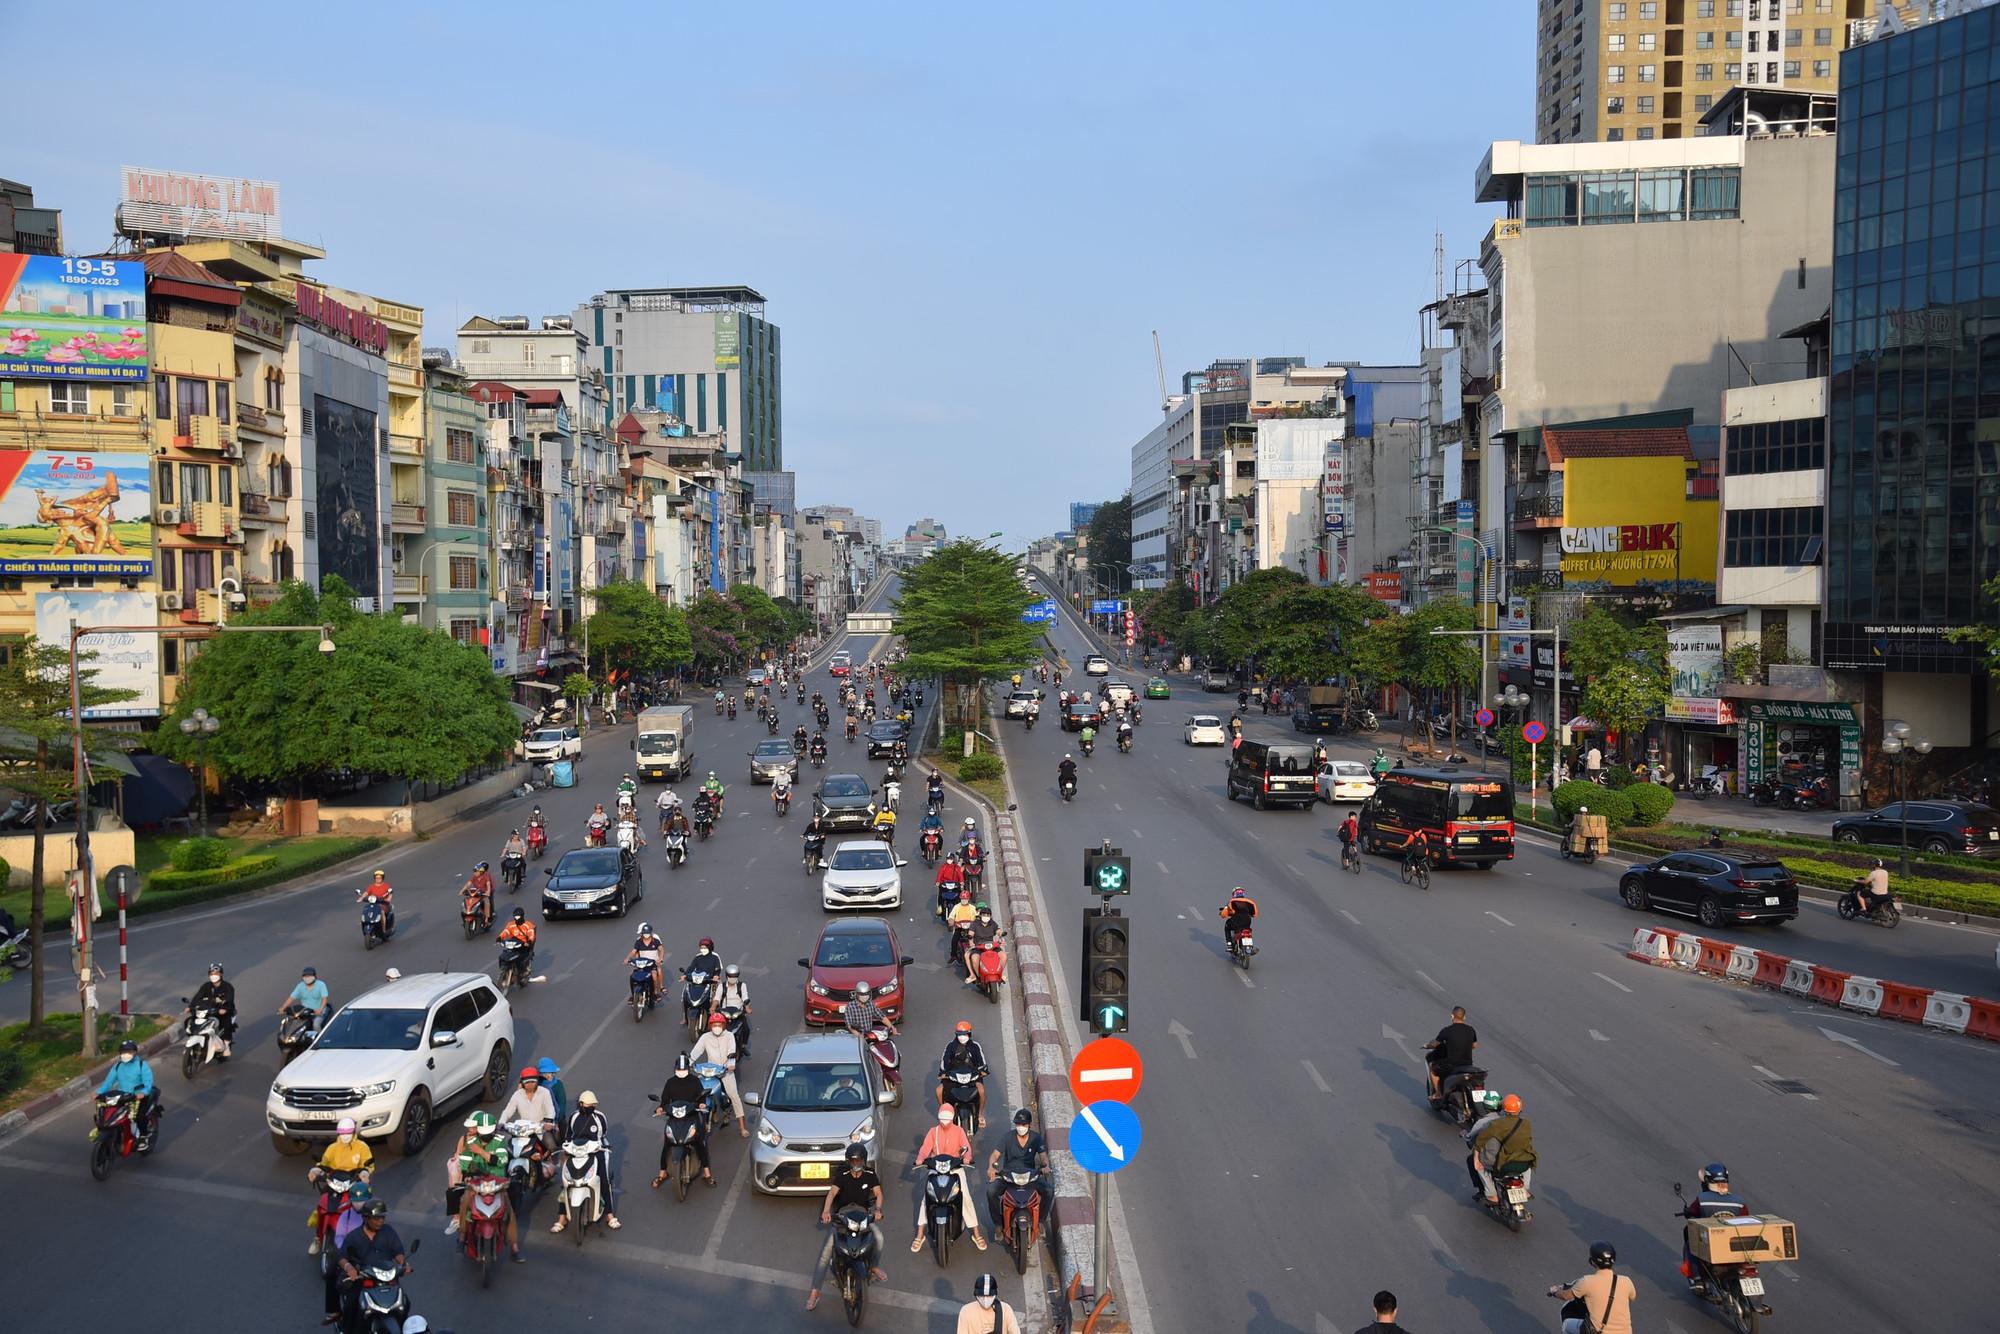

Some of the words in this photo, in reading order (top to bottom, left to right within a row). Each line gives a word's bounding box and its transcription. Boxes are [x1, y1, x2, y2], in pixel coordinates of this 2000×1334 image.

[127, 173, 220, 210] KHƯƠNG
[226, 179, 275, 215] LÂM
[62, 259, 116, 276] 19-5
[60, 275, 119, 286] 1890-2023
[296, 281, 320, 322] NHA
[322, 294, 350, 336] KHOA
[10, 362, 29, 372] CHỦ
[32, 365, 52, 374] TỊCH
[54, 363, 66, 373] HỒ
[69, 365, 84, 374] CHÍ
[86, 367, 110, 375] MINH
[122, 368, 137, 378] ĐẠI
[47, 456, 93, 471] 7-5
[1328, 458, 1341, 469] MÁY
[1328, 473, 1342, 482] BƠM
[1326, 483, 1344, 494] NƯỚC
[1621, 523, 1677, 551] BUK
[4, 561, 35, 572] CHIẾN
[38, 562, 70, 572] THẮNG
[73, 563, 96, 573] ĐIỆN
[98, 562, 121, 572] BIÊN
[123, 561, 143, 572] PHỦ
[1560, 560, 1588, 572] BUFFET
[1612, 555, 1642, 570] NƯỚNG
[1644, 552, 1677, 569] 179K
[1887, 625, 1900, 633] TÂM
[1901, 625, 1915, 633] BẢO
[1917, 625, 1935, 633] HÀNH
[1681, 643, 1688, 651] DA
[1690, 641, 1704, 651] VIỆT
[1706, 643, 1720, 651] NAM
[1766, 701, 1790, 716] ĐỒNG
[1791, 702, 1804, 717] HỒ
[1809, 705, 1829, 719] MÁY
[1829, 706, 1854, 720] TÍNH
[1720, 714, 1732, 723] DA
[1099, 866, 1122, 887] 52
